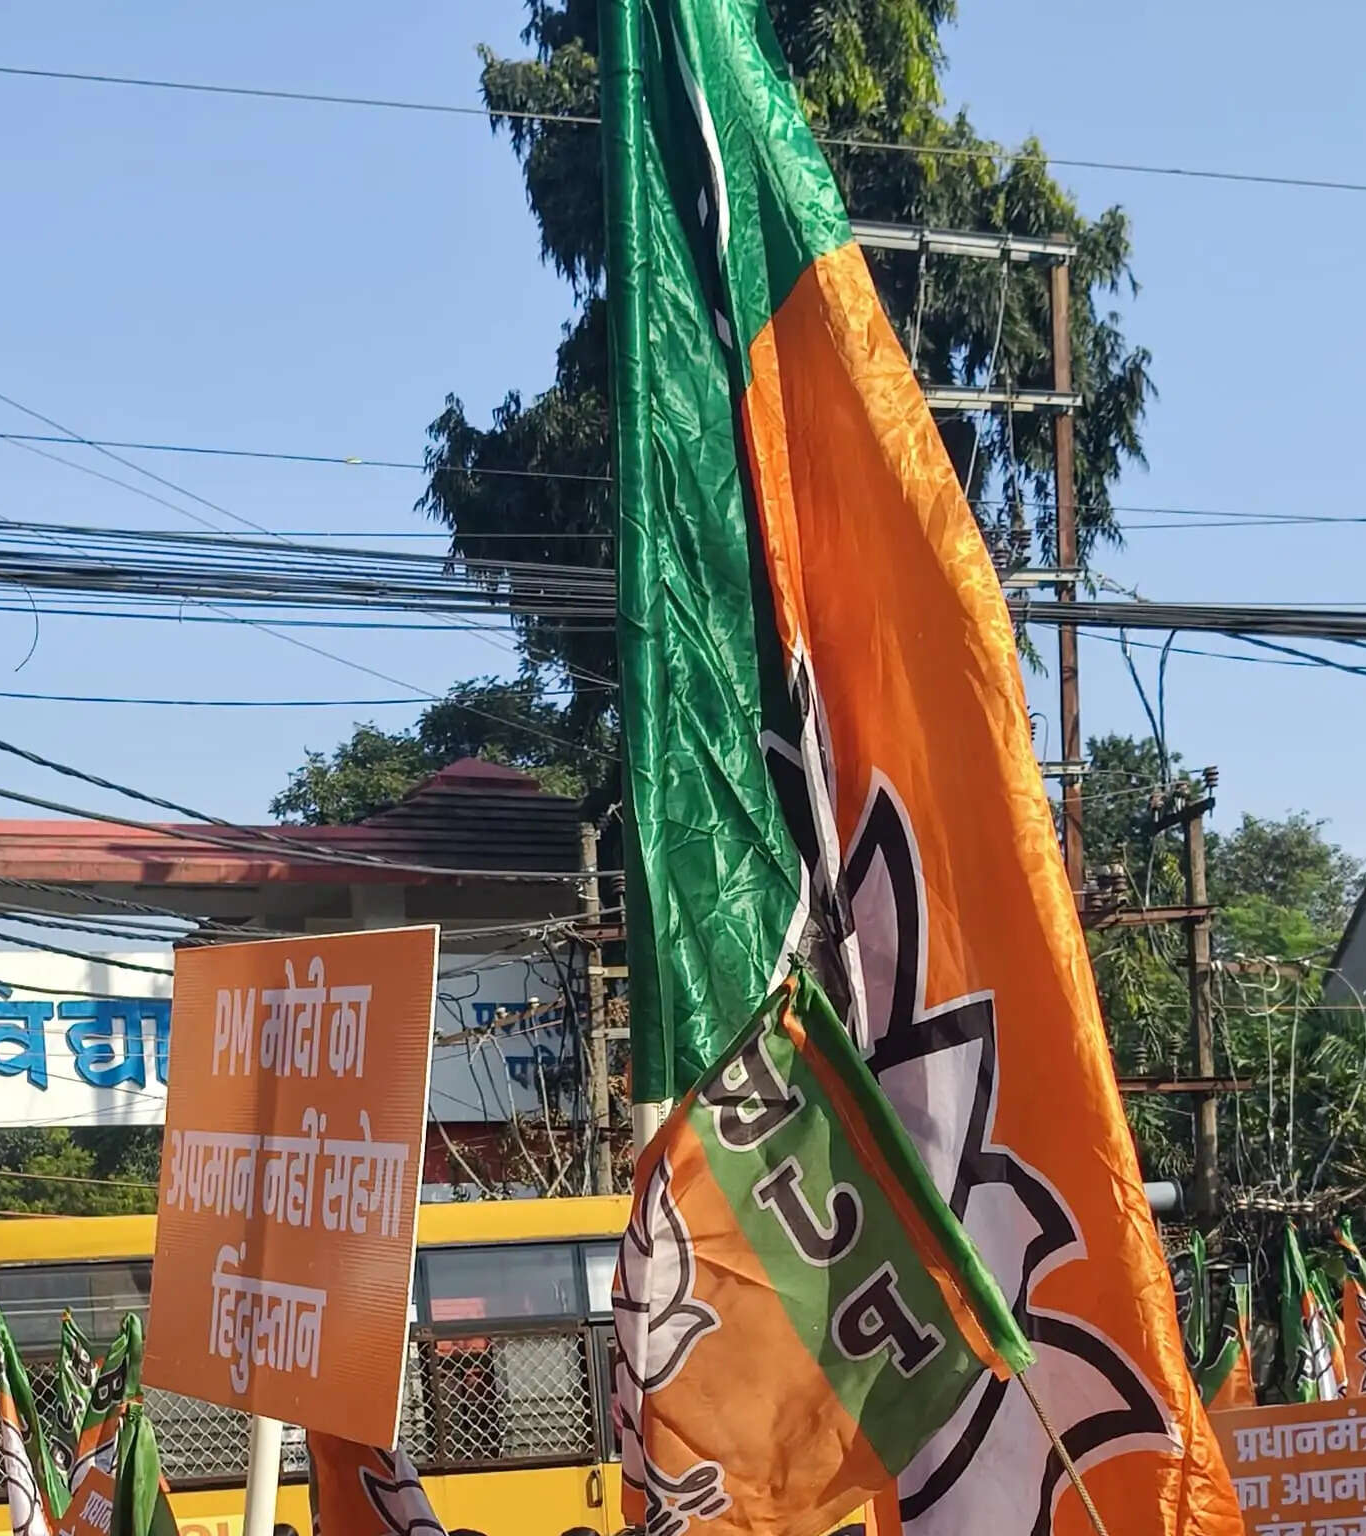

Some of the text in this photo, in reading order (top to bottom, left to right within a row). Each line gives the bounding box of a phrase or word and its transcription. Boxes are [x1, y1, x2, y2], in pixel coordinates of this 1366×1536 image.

[212, 956, 372, 1078] PM मोदी का
[166, 1107, 409, 1240] अपमान नहीं सहेगा
[209, 1244, 326, 1394] हिंदुस्तान
